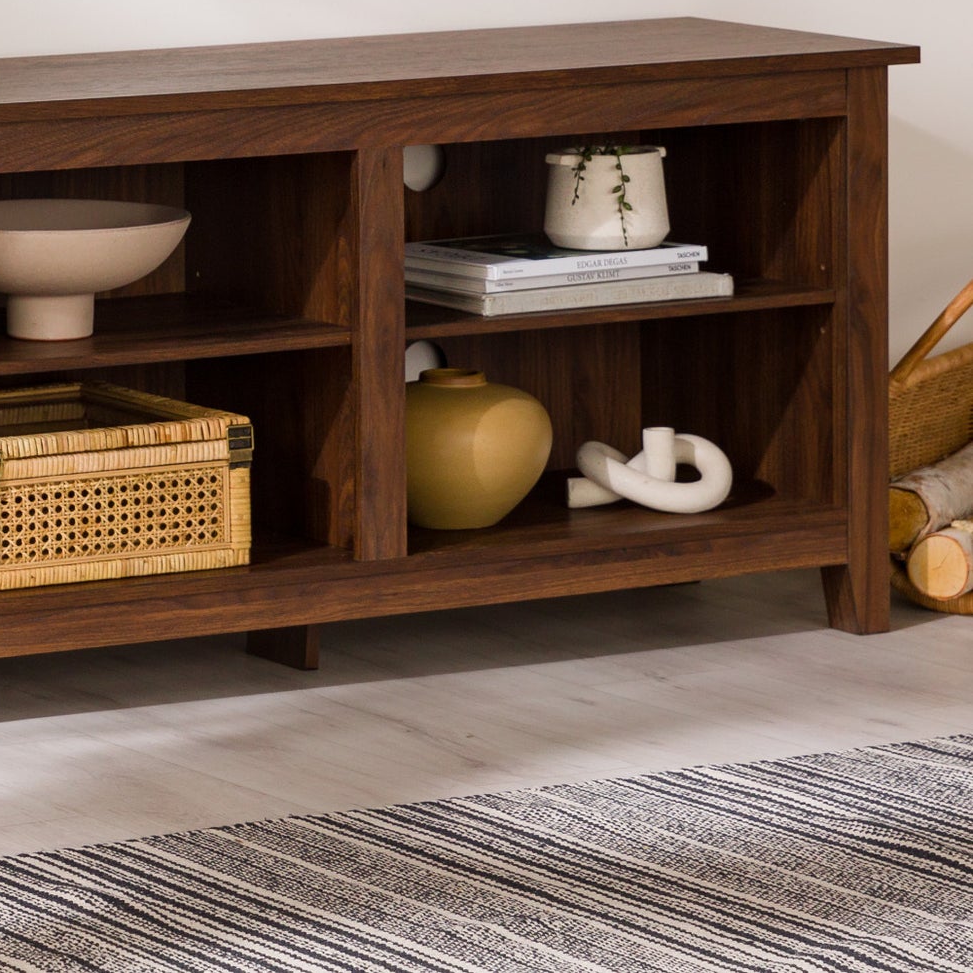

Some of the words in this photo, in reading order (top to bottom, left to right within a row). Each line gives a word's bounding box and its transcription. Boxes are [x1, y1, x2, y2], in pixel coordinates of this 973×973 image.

[577, 259, 602, 268] EDGAR
[604, 257, 627, 266] DEGAS
[567, 271, 595, 282] GUSTAV
[597, 268, 619, 279] KLIMT
